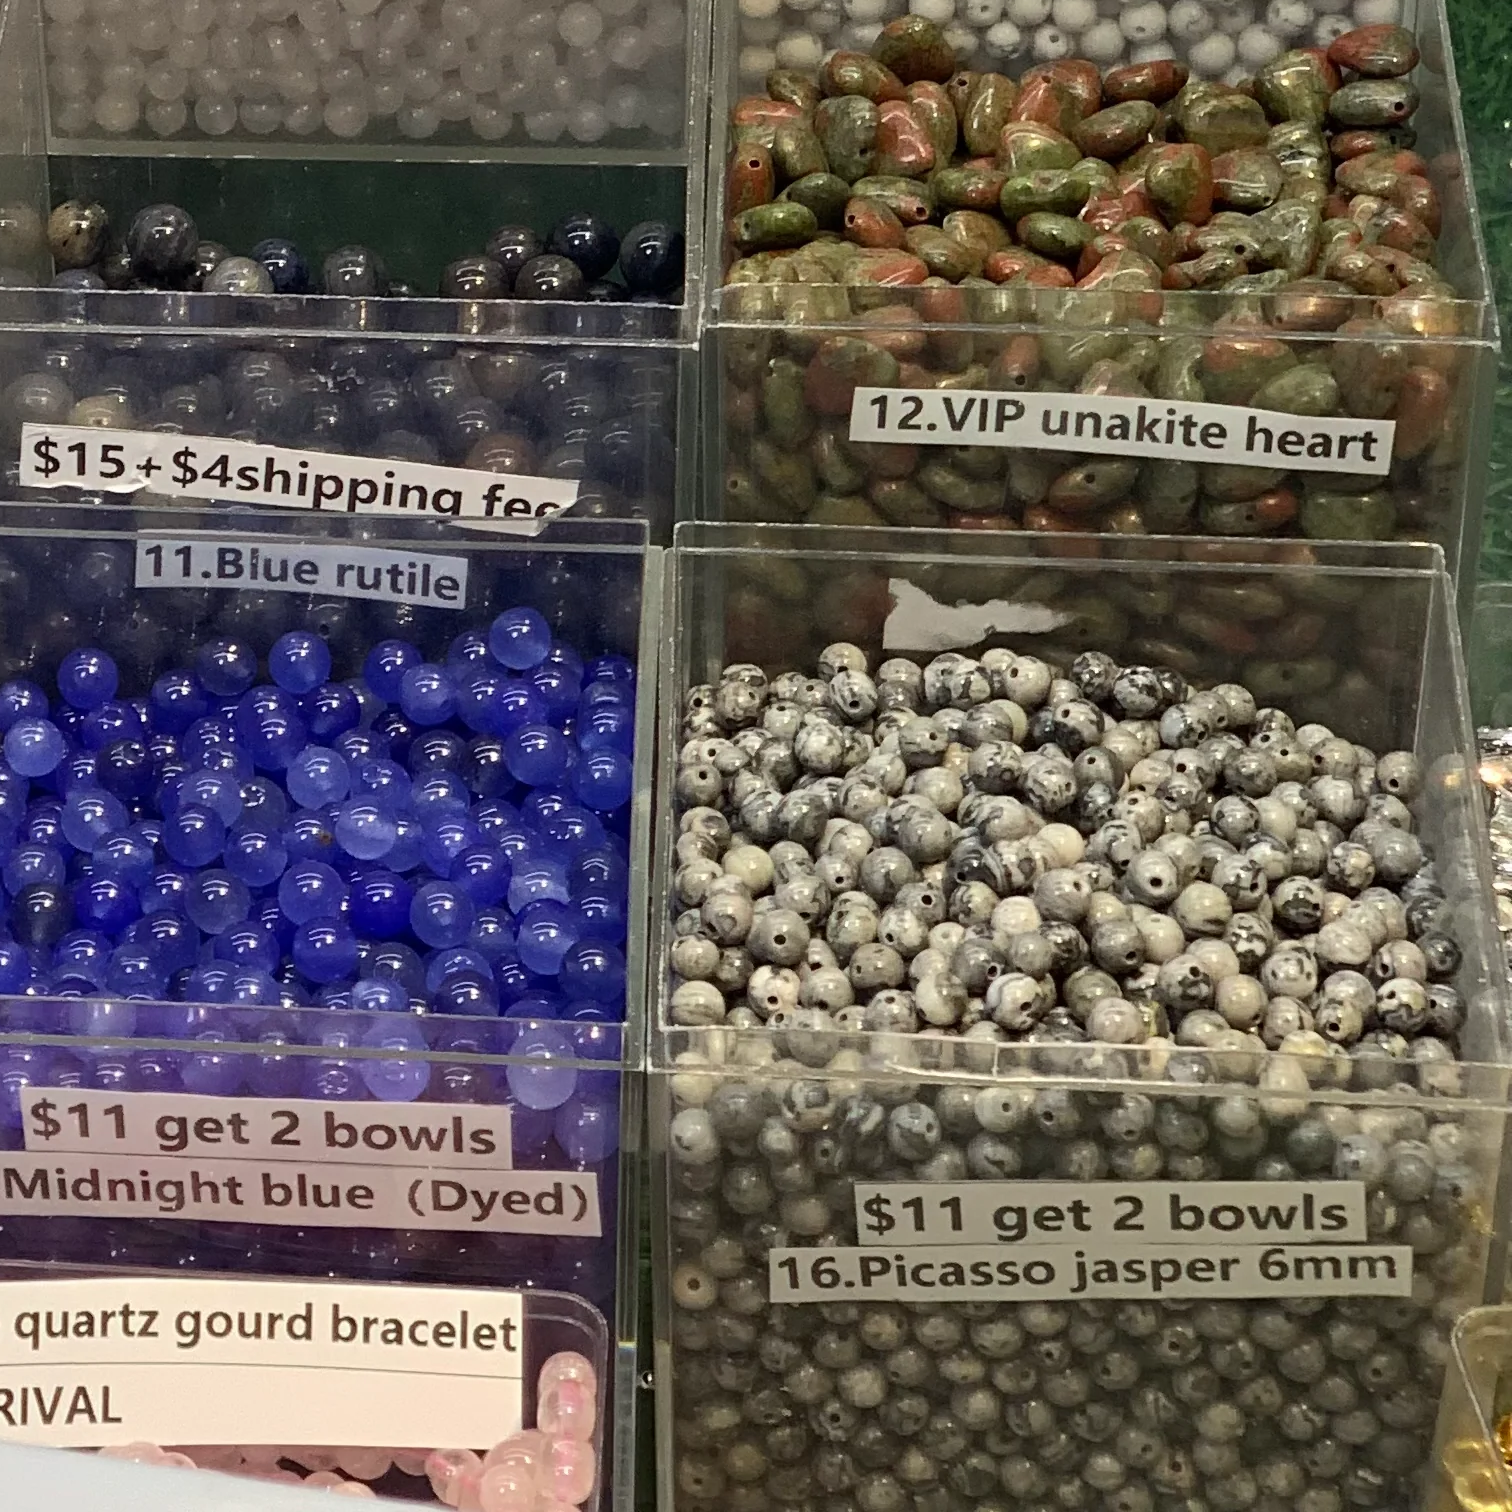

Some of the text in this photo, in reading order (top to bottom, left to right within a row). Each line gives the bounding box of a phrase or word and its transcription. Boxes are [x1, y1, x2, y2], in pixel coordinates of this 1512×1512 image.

[869, 395, 1379, 462] 12.VIP unakite heart
[144, 544, 461, 601] 11.Blue rutile
[30, 1098, 497, 1156] $11 get 2 bowls
[261, 1174, 375, 1210] blue
[408, 1178, 589, 1224] (Dyed)
[862, 1193, 1350, 1243] $11 get 2 bowls
[777, 1248, 1399, 1293] 16.Picasso jasper 6mm
[13, 1303, 159, 1350] quartz
[174, 1303, 314, 1347] gourd
[330, 1303, 517, 1352] bracelet
